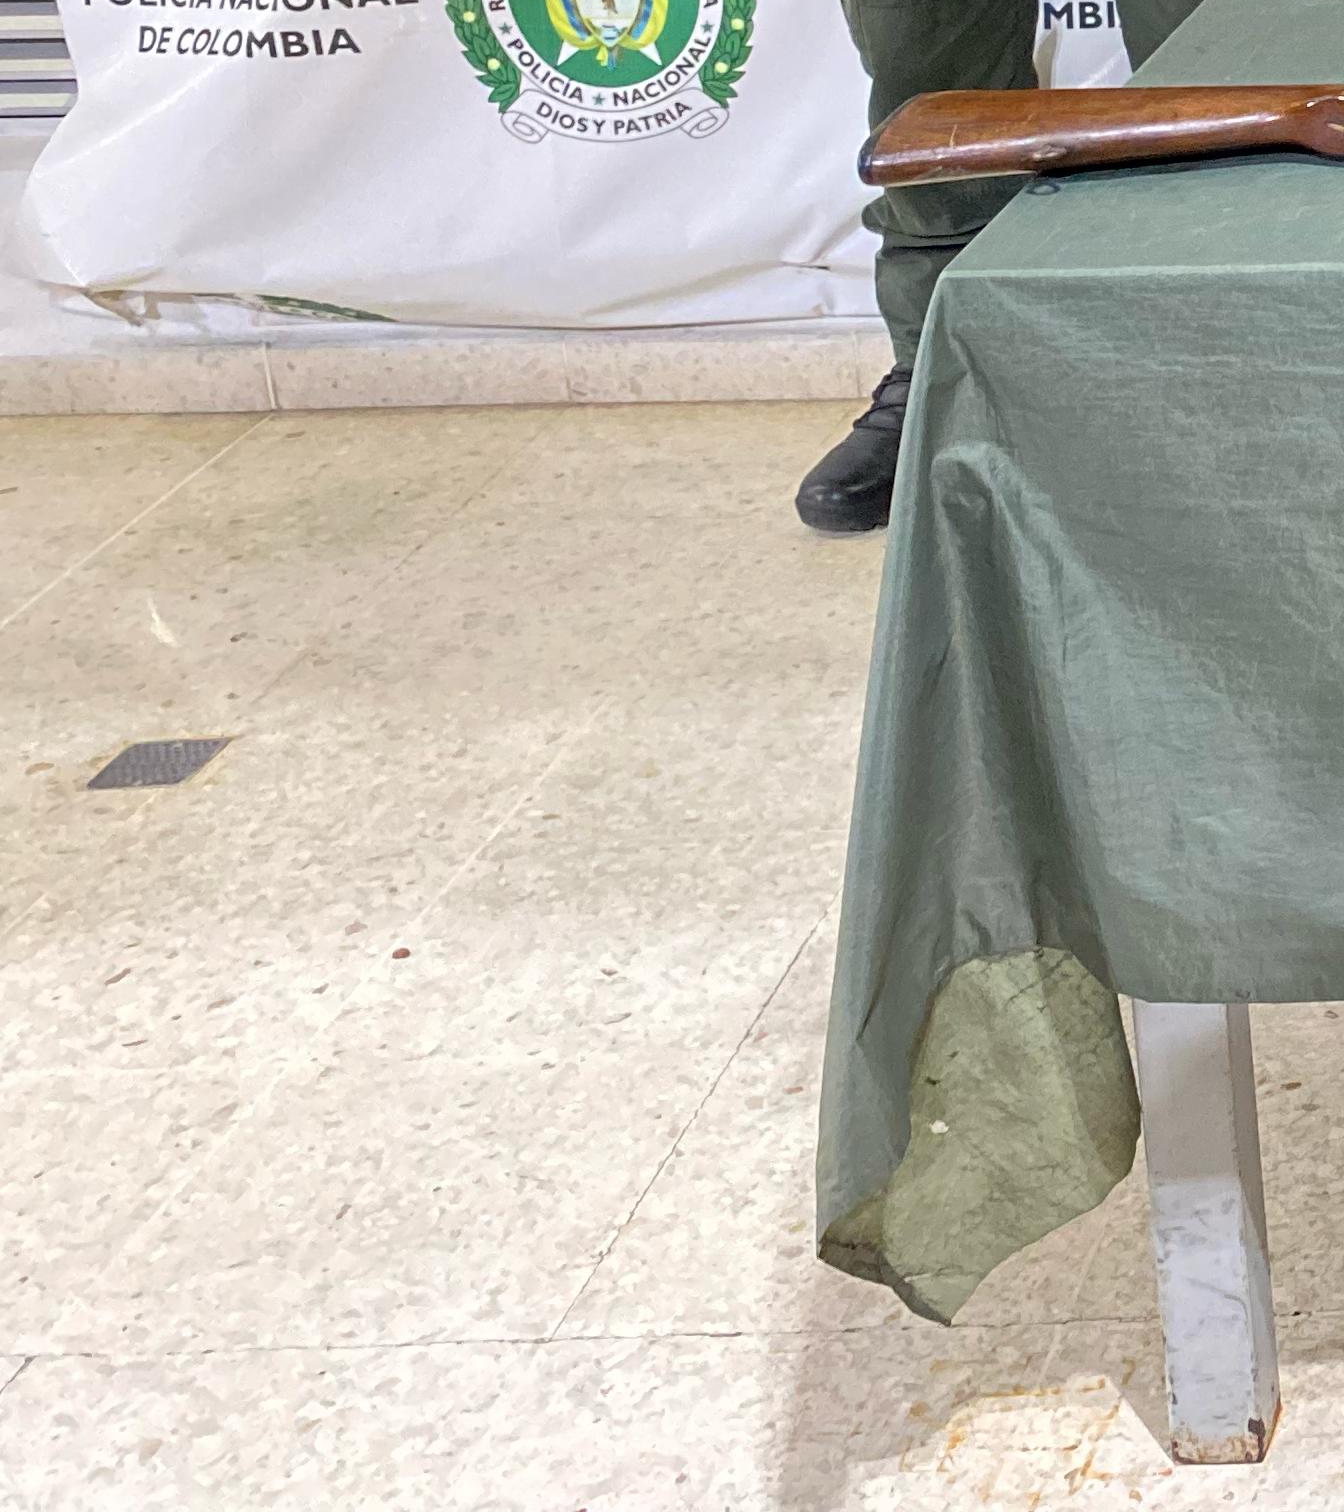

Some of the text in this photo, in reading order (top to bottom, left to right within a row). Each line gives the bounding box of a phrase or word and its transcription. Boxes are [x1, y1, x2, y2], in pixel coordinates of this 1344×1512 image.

[138, 25, 363, 58] DE COLOMBIA
[613, 36, 711, 107] NACIONAL
[613, 101, 693, 135] PATRIA
